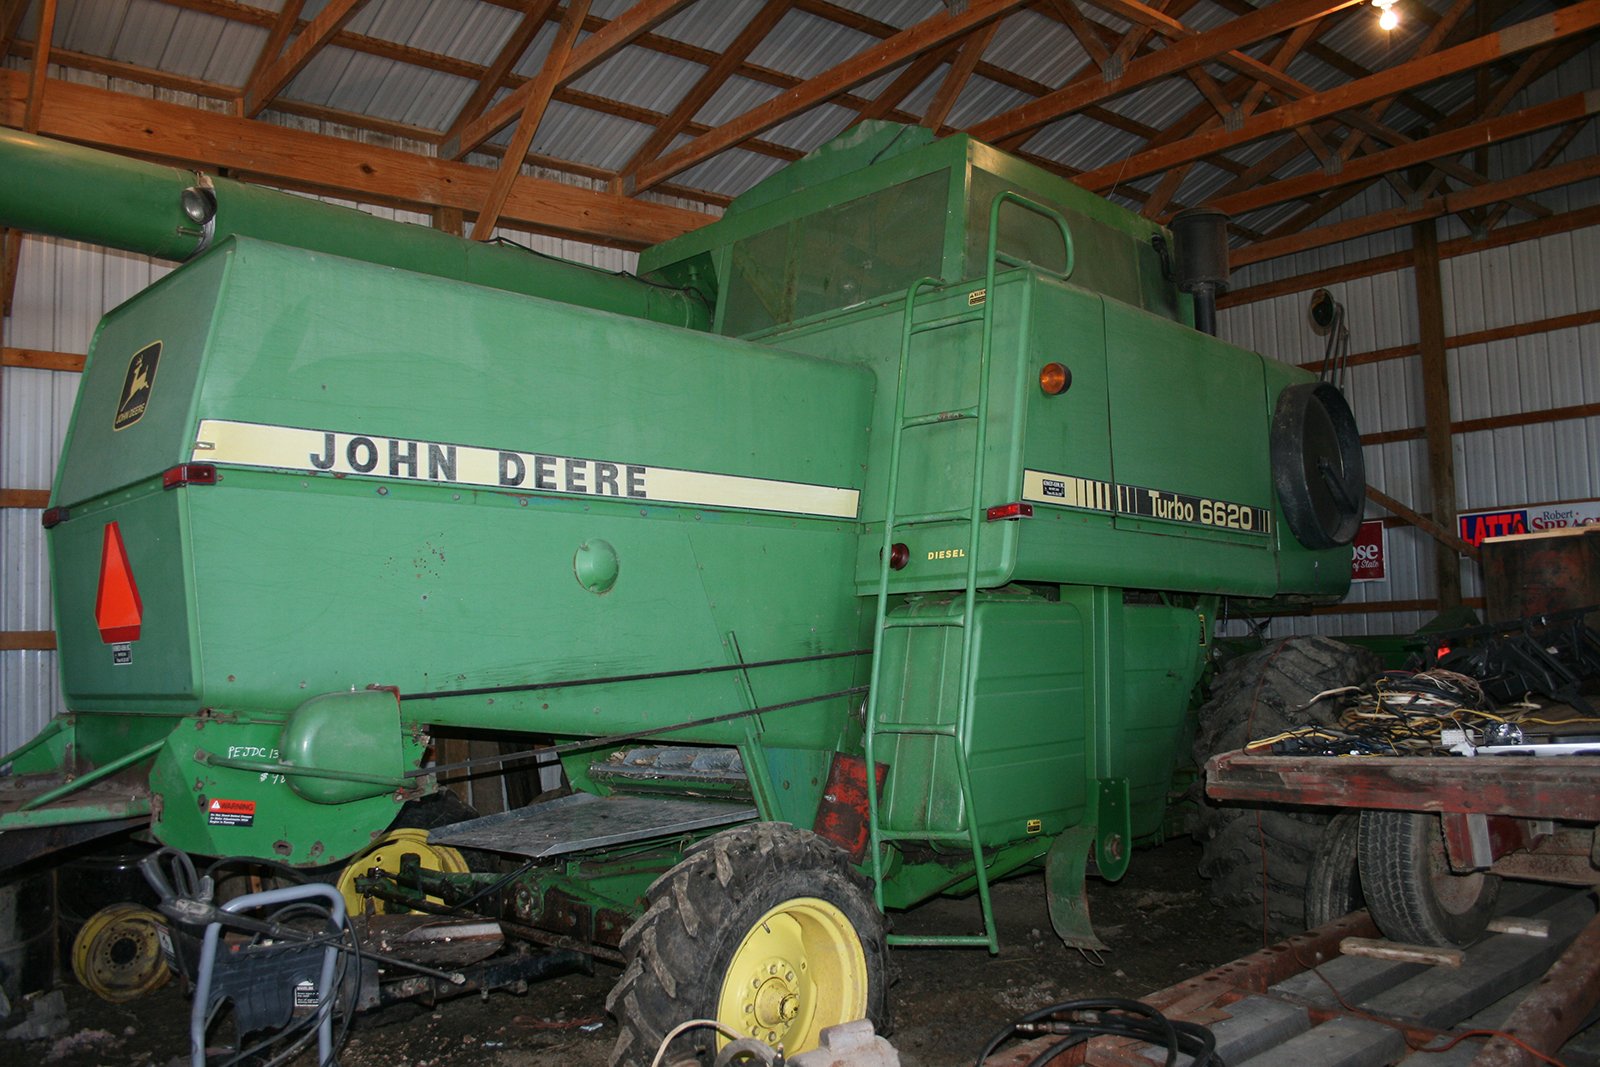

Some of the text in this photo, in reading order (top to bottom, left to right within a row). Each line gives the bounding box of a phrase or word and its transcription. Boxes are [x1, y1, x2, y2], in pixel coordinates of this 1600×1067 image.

[310, 433, 647, 498] JOHN DEERE
[1148, 490, 1252, 530] Turbo 6620
[1543, 509, 1573, 520] Robert
[928, 549, 965, 560] DIESEL
[221, 802, 254, 811] WARNING
